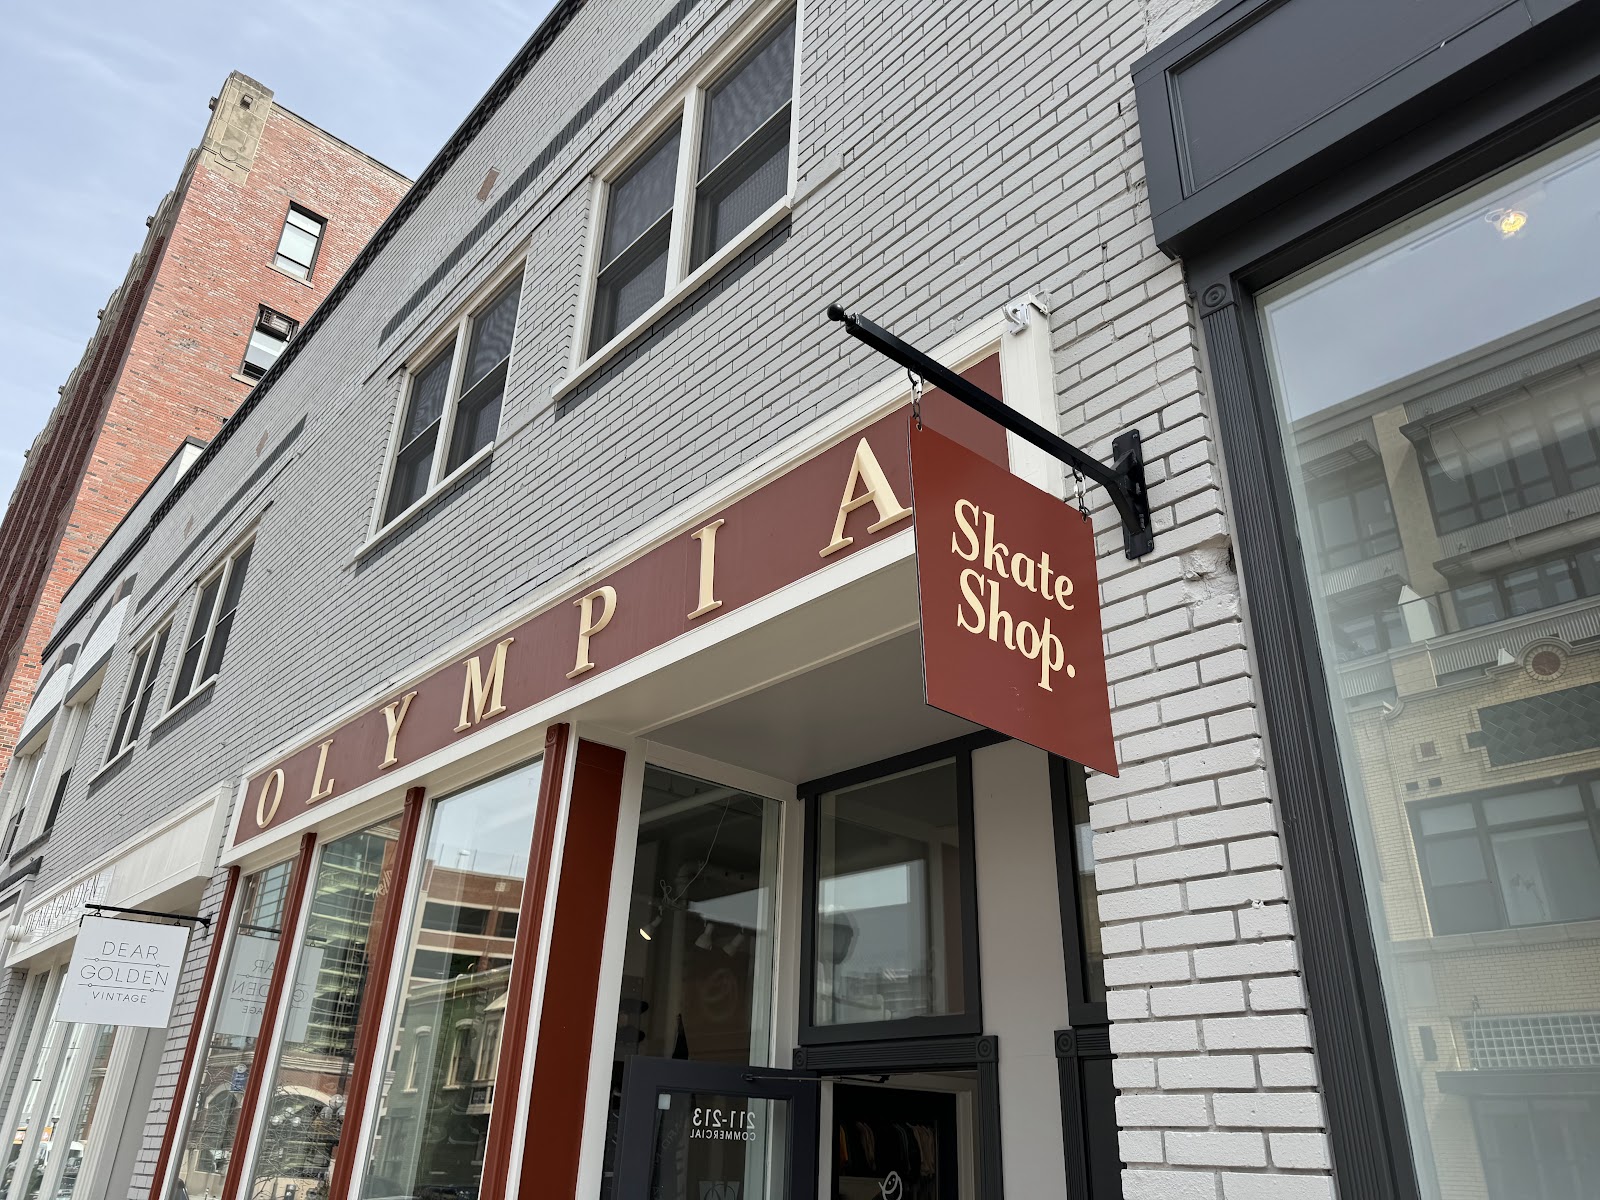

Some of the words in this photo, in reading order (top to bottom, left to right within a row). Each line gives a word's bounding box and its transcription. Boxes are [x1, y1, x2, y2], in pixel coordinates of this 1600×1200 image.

[951, 498, 1075, 611] Skate
[256, 436, 913, 829] OLYMPIA
[957, 568, 1076, 692] Shop.
[55, 873, 101, 919] GOLDEN
[101, 940, 159, 960] DEAR
[80, 964, 169, 986] GOLDEN
[92, 990, 148, 1004] VINTAGE
